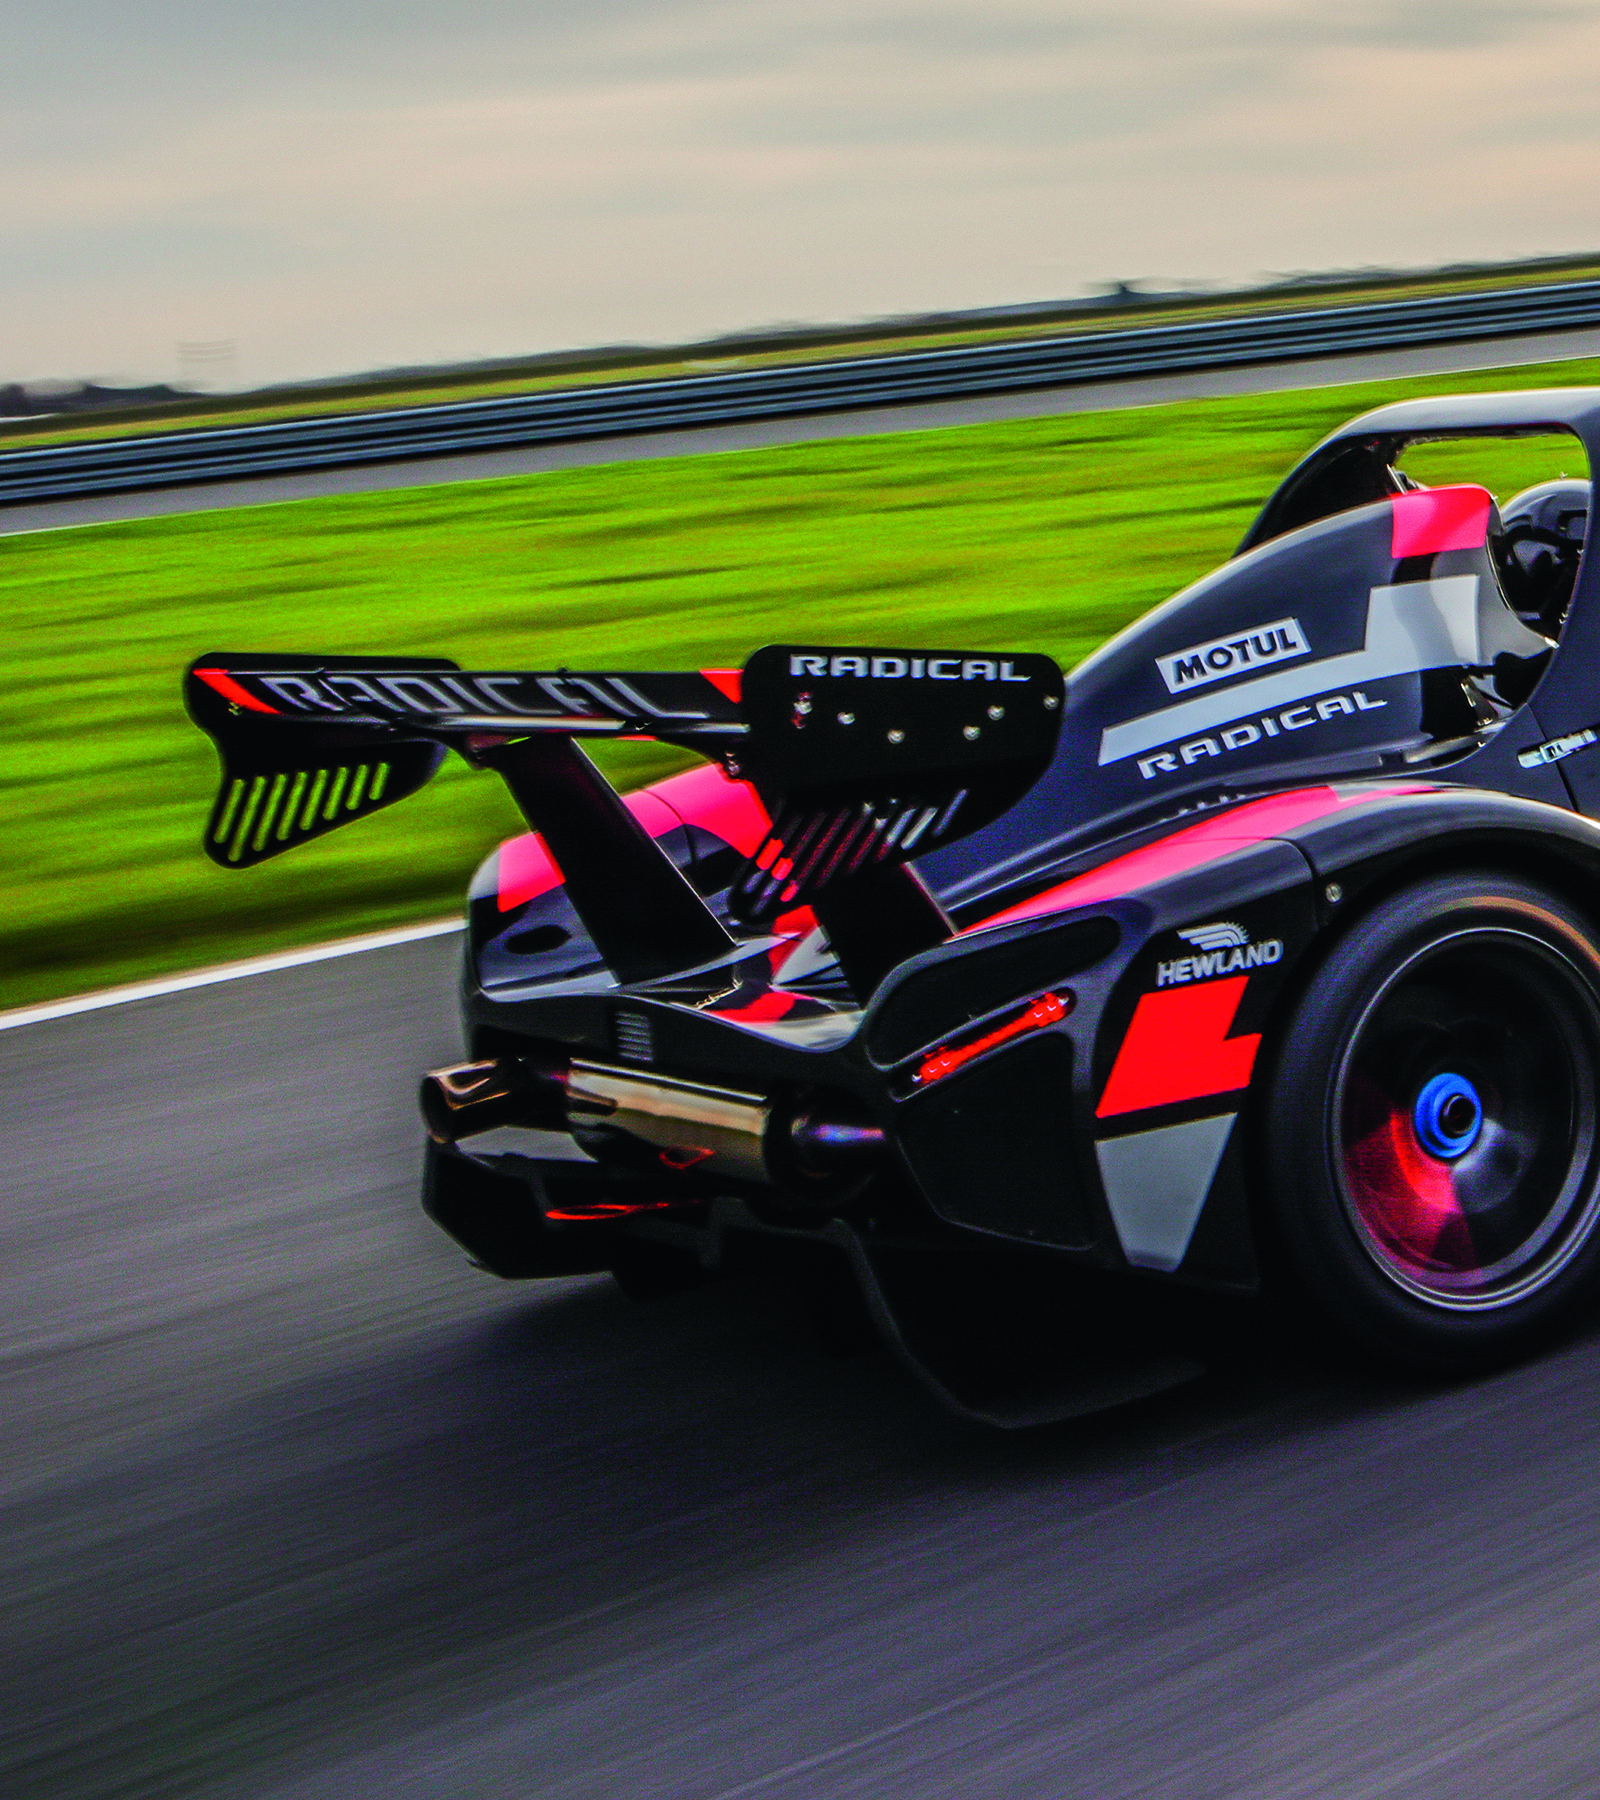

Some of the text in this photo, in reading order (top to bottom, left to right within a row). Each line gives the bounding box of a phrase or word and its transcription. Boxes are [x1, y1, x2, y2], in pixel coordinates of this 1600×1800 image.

[789, 653, 1031, 682] RADICAL
[1174, 627, 1297, 684] MOTUL
[258, 676, 711, 719] RADICAL
[1137, 691, 1388, 780] RADICAL
[1156, 938, 1284, 987] HEWLAND
